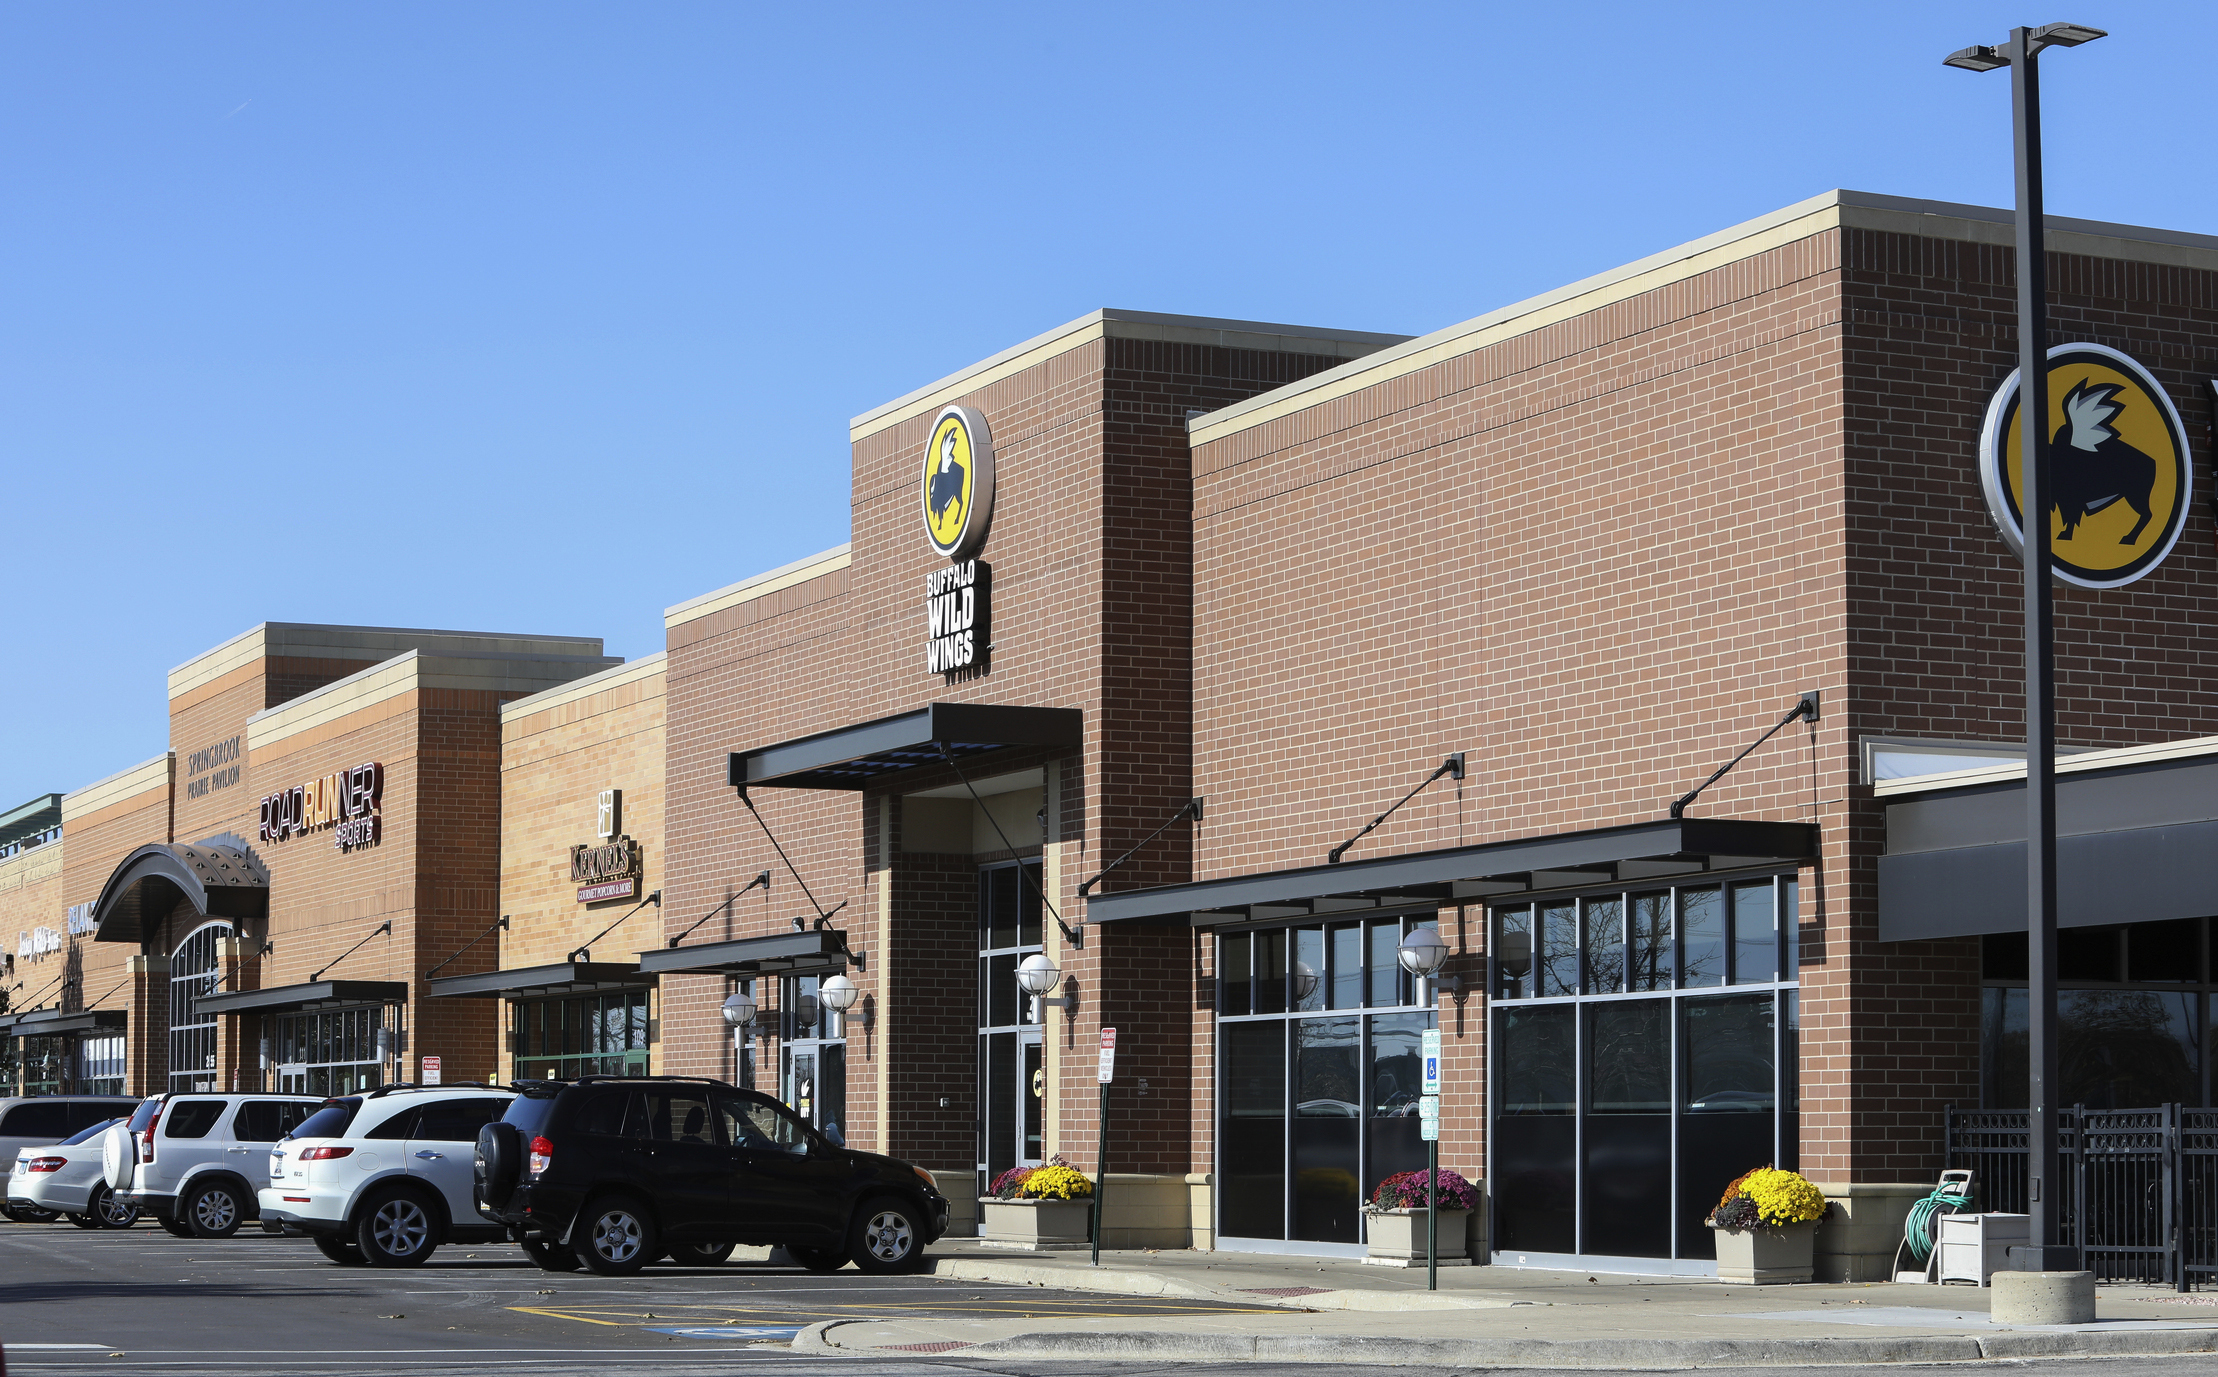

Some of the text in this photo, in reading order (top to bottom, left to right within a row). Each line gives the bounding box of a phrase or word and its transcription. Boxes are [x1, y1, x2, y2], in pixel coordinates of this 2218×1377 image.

[926, 559, 975, 598] BUFFALO
[926, 586, 975, 640] WILD
[925, 629, 974, 675] WINGS
[187, 734, 240, 777] SPRINGBROOK
[187, 764, 240, 801] PRAIRIE PAVILION
[259, 761, 376, 843] ROADRUNNER
[334, 814, 374, 850] SPORTS
[570, 834, 629, 883] KERNEL'S
[577, 887, 598, 901] GOURMET
[597, 884, 616, 898] POPCORN
[619, 881, 632, 894] MORE
[1423, 1036, 1440, 1044] RESERVED
[1424, 1047, 1439, 1055] PARKING
